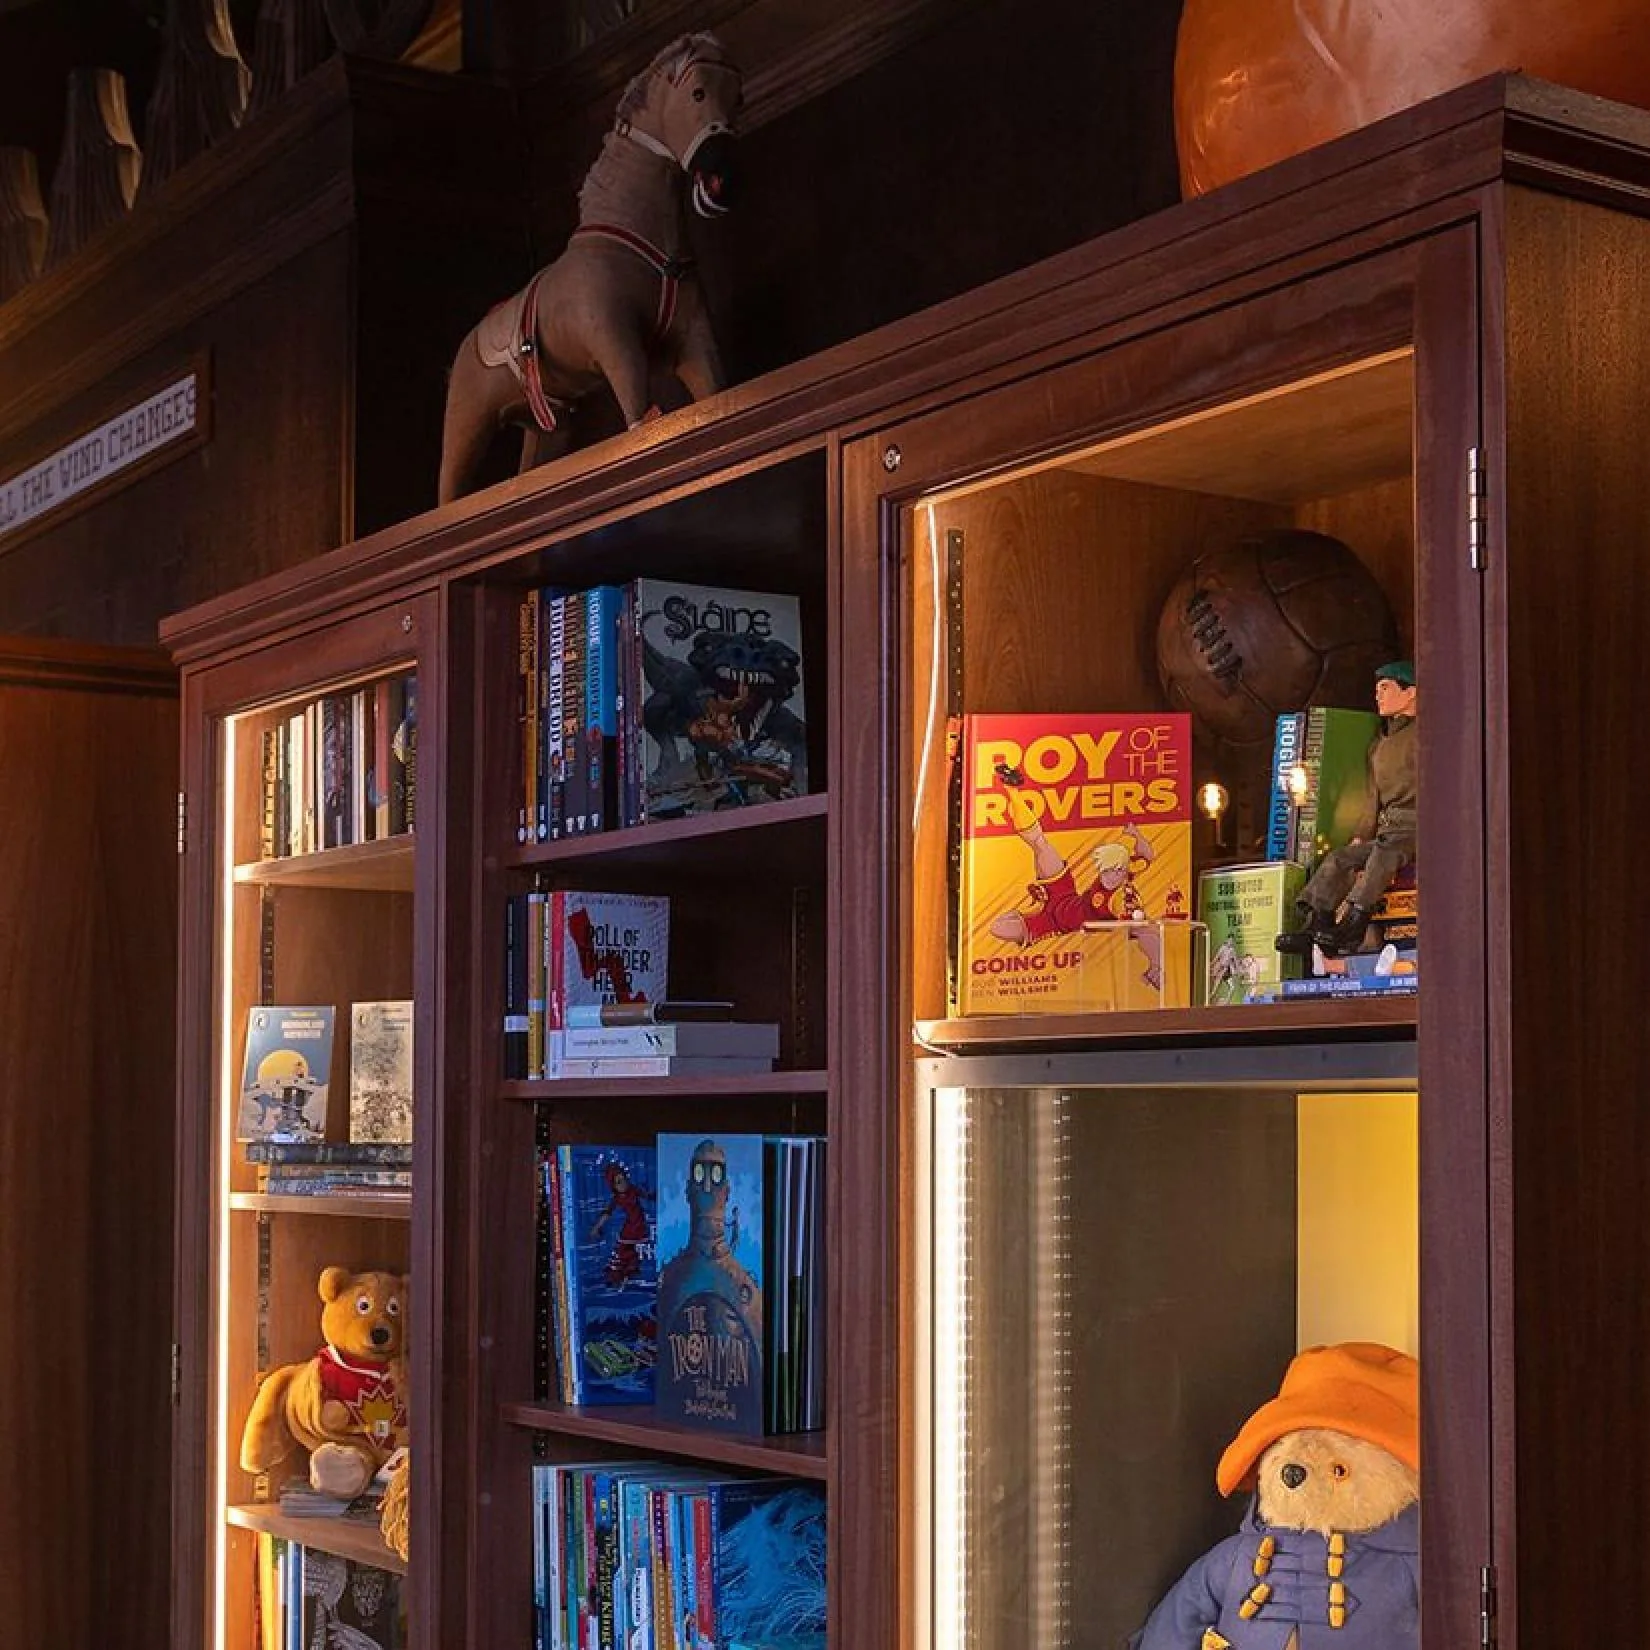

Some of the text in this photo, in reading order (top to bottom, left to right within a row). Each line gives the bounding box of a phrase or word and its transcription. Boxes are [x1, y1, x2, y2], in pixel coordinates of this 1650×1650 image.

[22, 466, 55, 512] THE
[60, 438, 104, 489] WIND
[108, 383, 196, 463] CHANGES
[975, 725, 1172, 788] ROY OF
[1123, 750, 1178, 777] THE
[975, 779, 1179, 828] ROVERS
[623, 929, 641, 946] OF
[972, 953, 1047, 975] GOING
[1053, 951, 1085, 969] UP
[593, 971, 633, 992] HER
